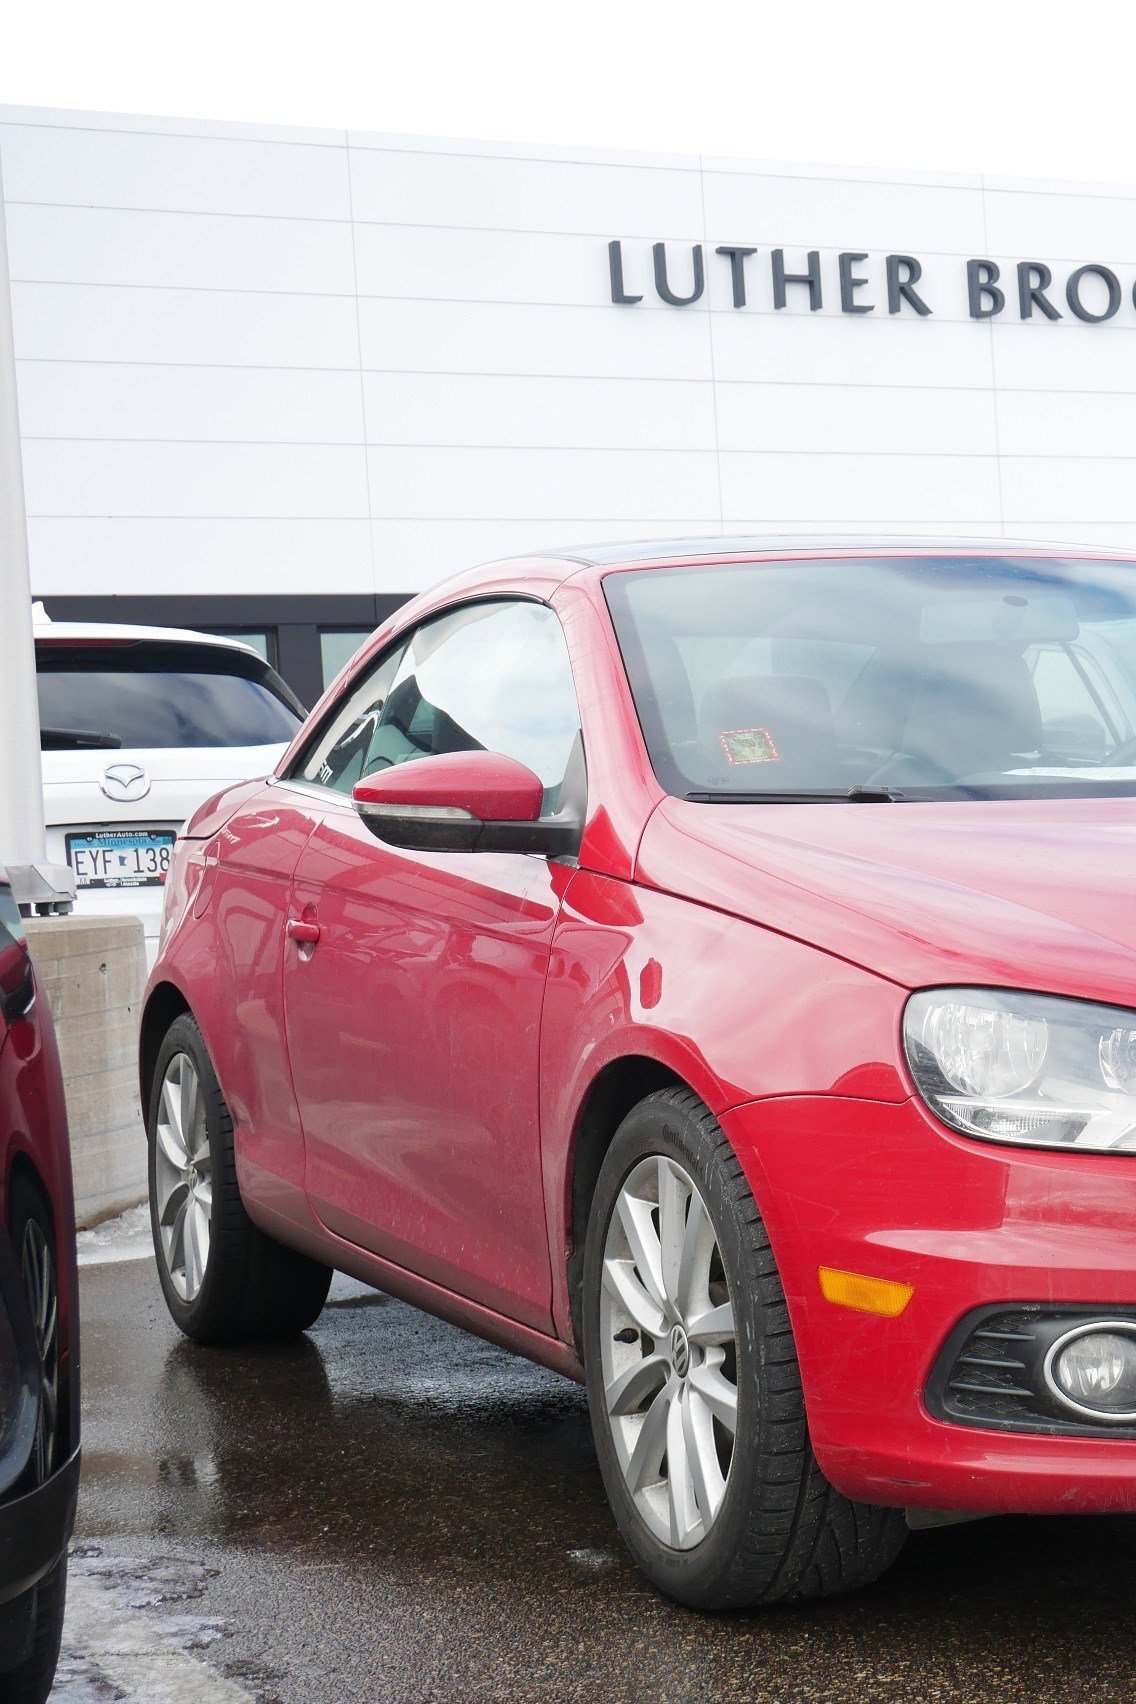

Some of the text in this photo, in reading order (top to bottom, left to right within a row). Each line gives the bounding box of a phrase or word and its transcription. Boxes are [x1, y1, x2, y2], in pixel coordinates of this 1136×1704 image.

[608, 240, 933, 316] LUTHER
[98, 838, 147, 846] Minnesota
[74, 847, 170, 876] EYF 138
